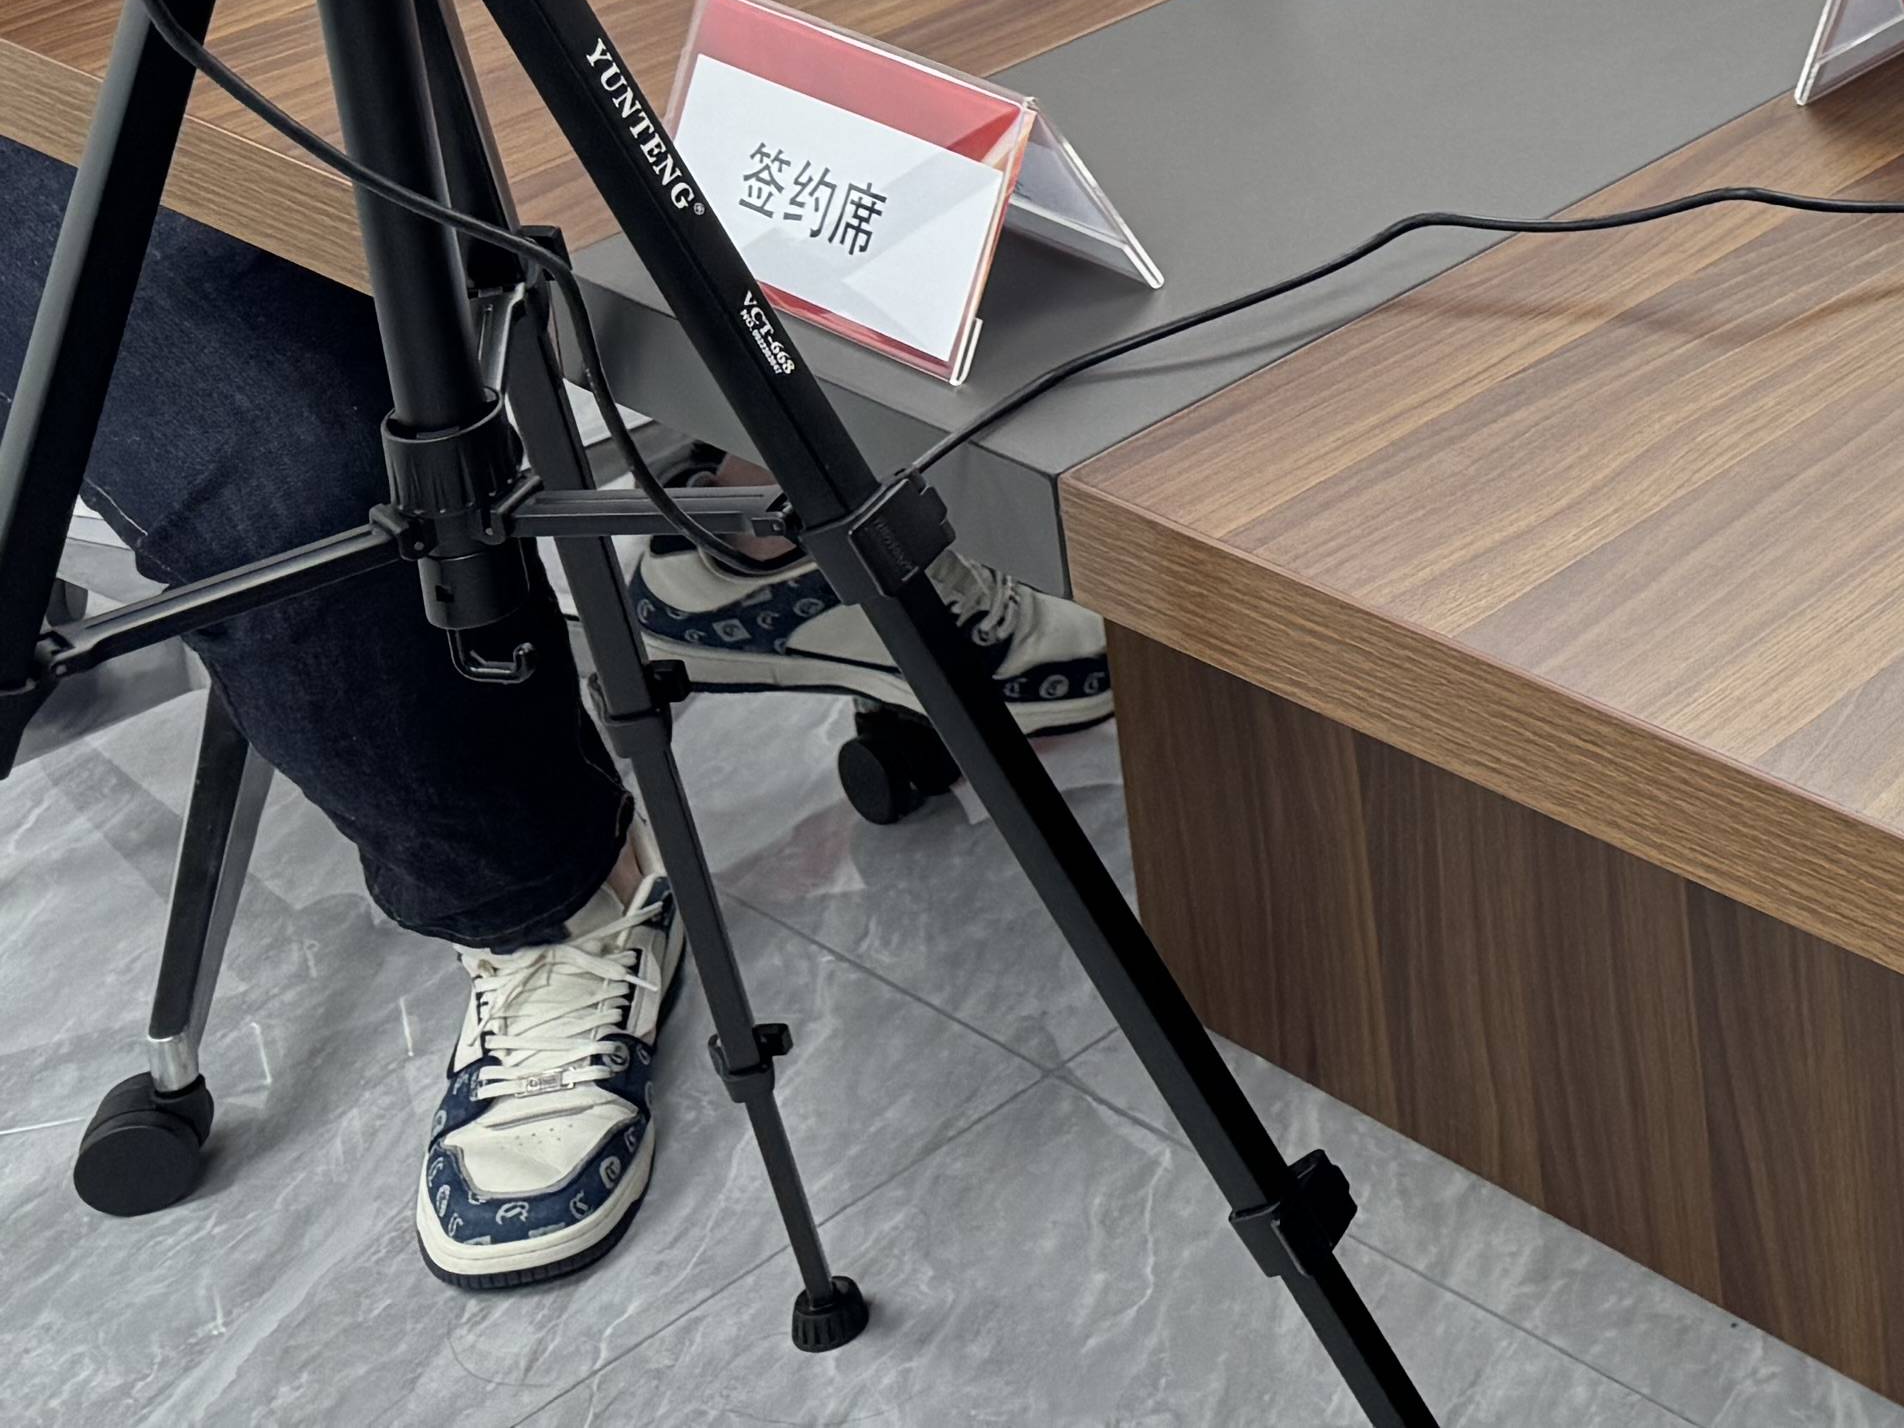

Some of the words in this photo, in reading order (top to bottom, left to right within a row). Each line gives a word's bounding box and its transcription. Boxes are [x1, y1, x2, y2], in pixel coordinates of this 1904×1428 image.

[586, 37, 698, 213] YUNTENG
[737, 141, 888, 257] 签约席
[744, 290, 796, 375] VCT-668
